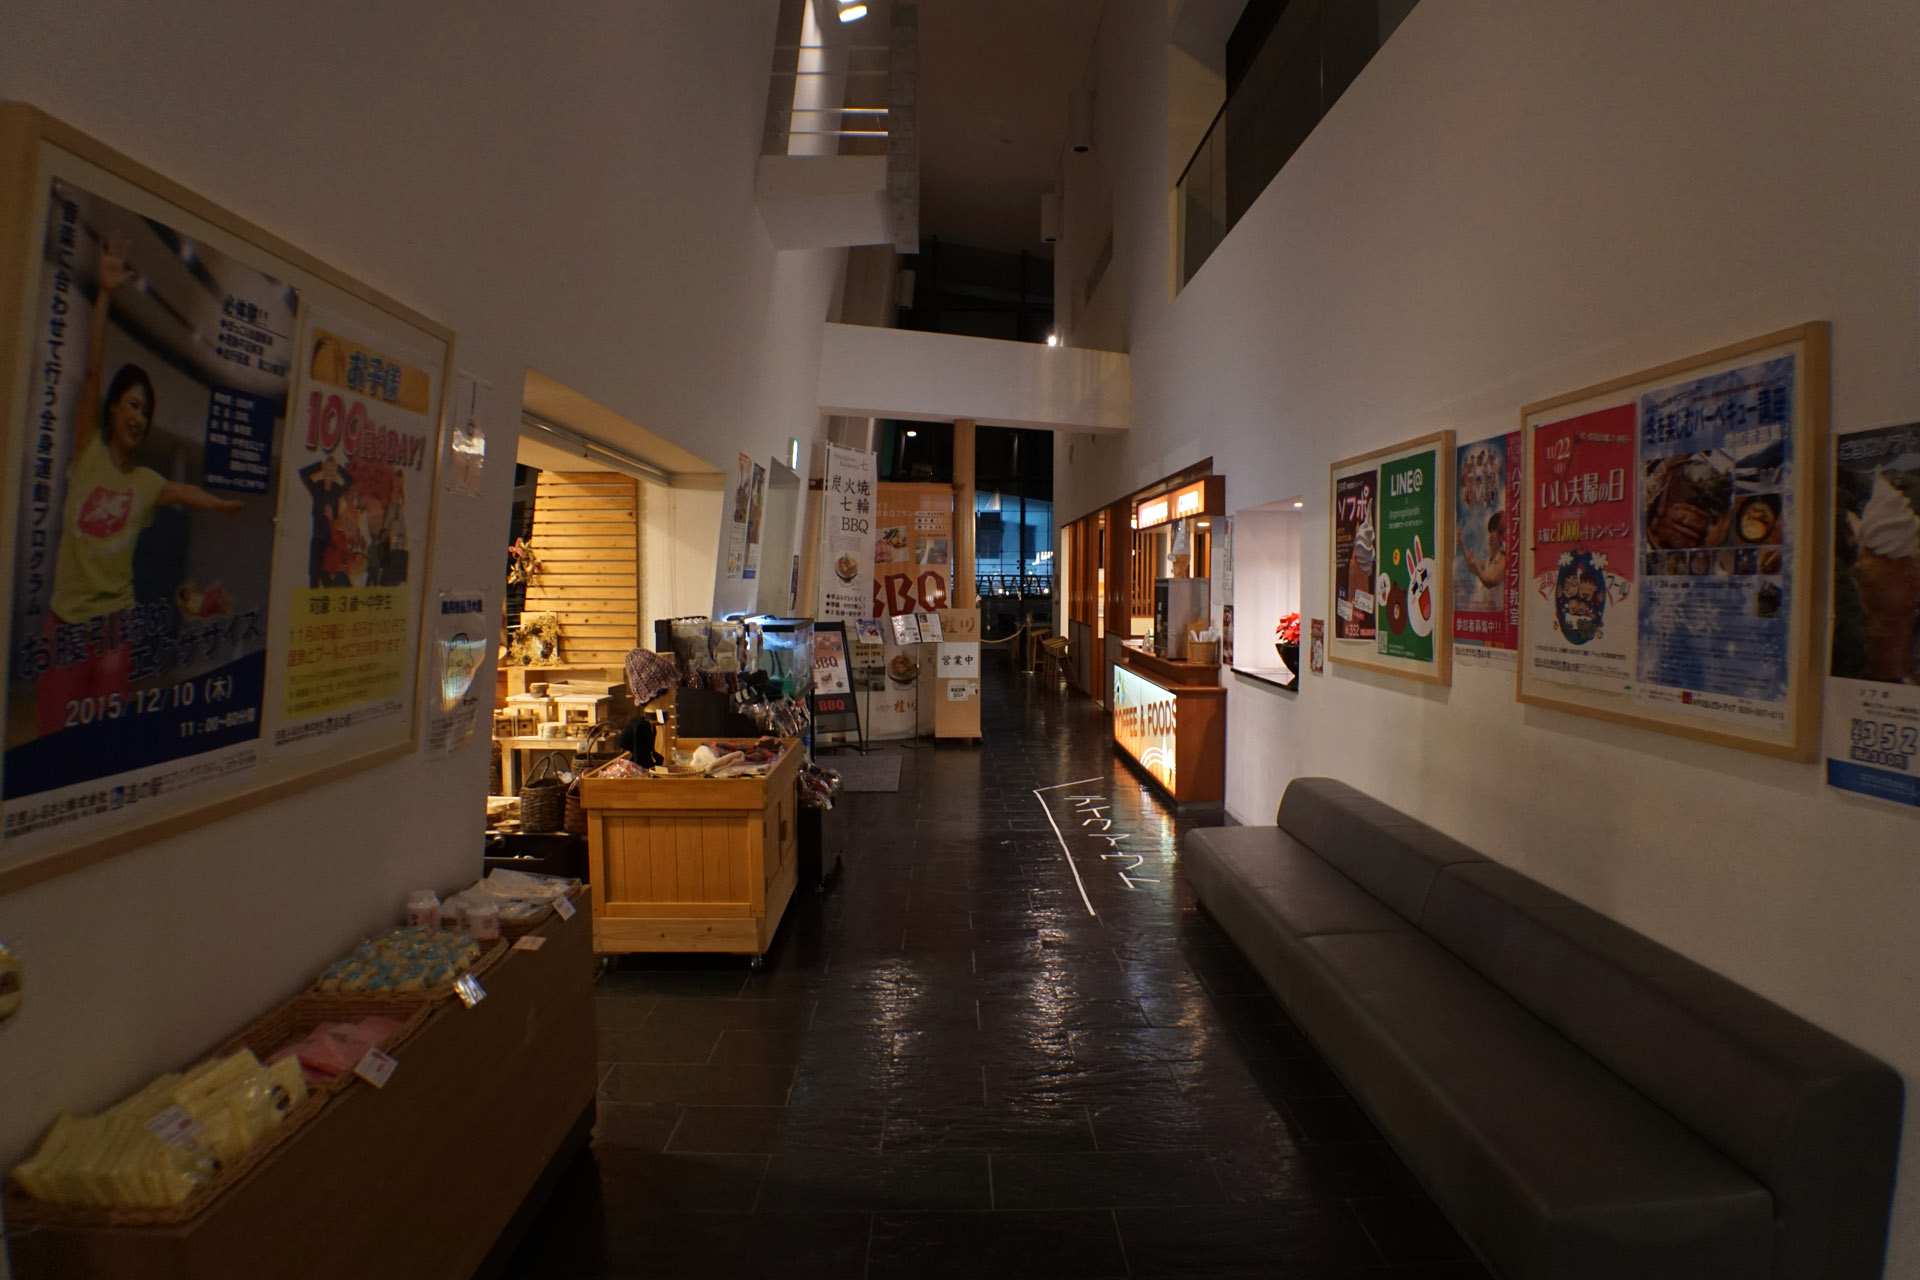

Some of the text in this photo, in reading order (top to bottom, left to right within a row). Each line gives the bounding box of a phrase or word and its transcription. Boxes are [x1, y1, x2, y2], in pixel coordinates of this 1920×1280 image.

[831, 474, 871, 497] 炭火焼
[1390, 468, 1424, 497] LINE@
[1541, 468, 1625, 508] いい夫婦の日
[840, 496, 870, 515] 七輪
[841, 516, 869, 535] BBQ
[941, 654, 974, 666] 営業中
[65, 674, 233, 728] 2015/12/10 (木)
[818, 699, 845, 712] BBQ
[1851, 718, 1919, 756] ¥352
